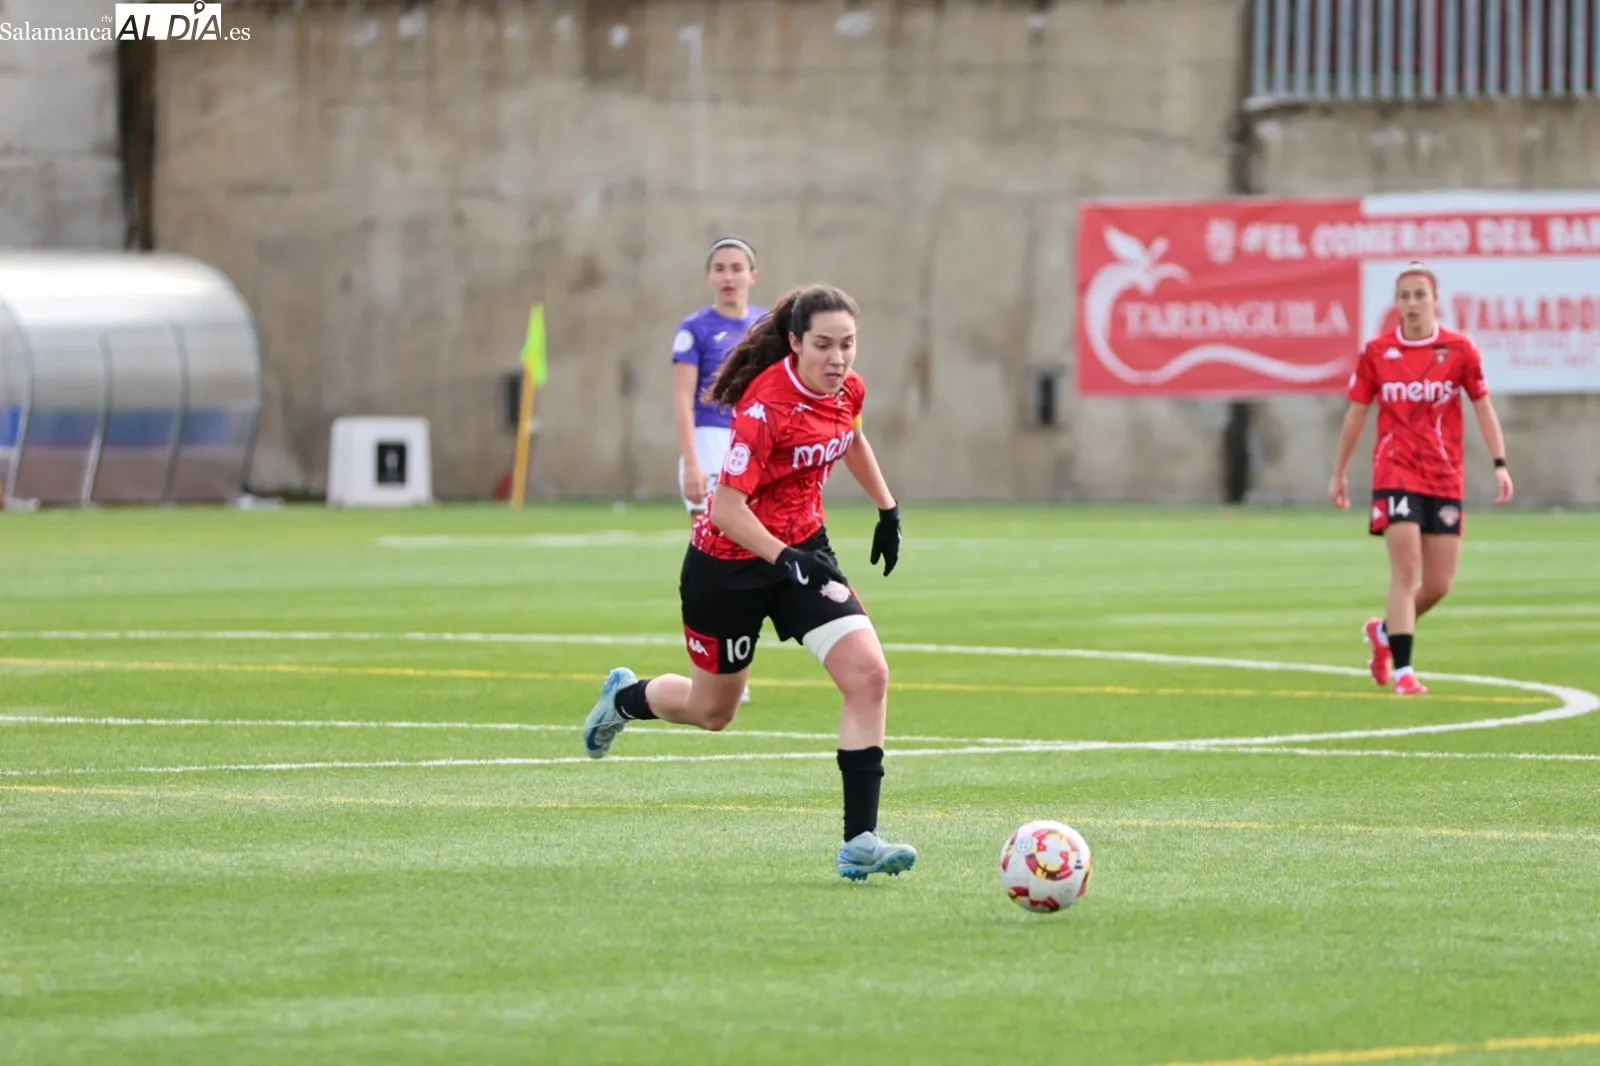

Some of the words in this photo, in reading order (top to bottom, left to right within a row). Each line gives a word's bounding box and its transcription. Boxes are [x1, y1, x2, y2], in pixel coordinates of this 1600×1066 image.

[1311, 217, 1471, 259] COMERCIO
[1476, 217, 1541, 254] DEL
[1382, 379, 1455, 402] meins
[1388, 496, 1411, 517] 14
[726, 635, 751, 663] 10
